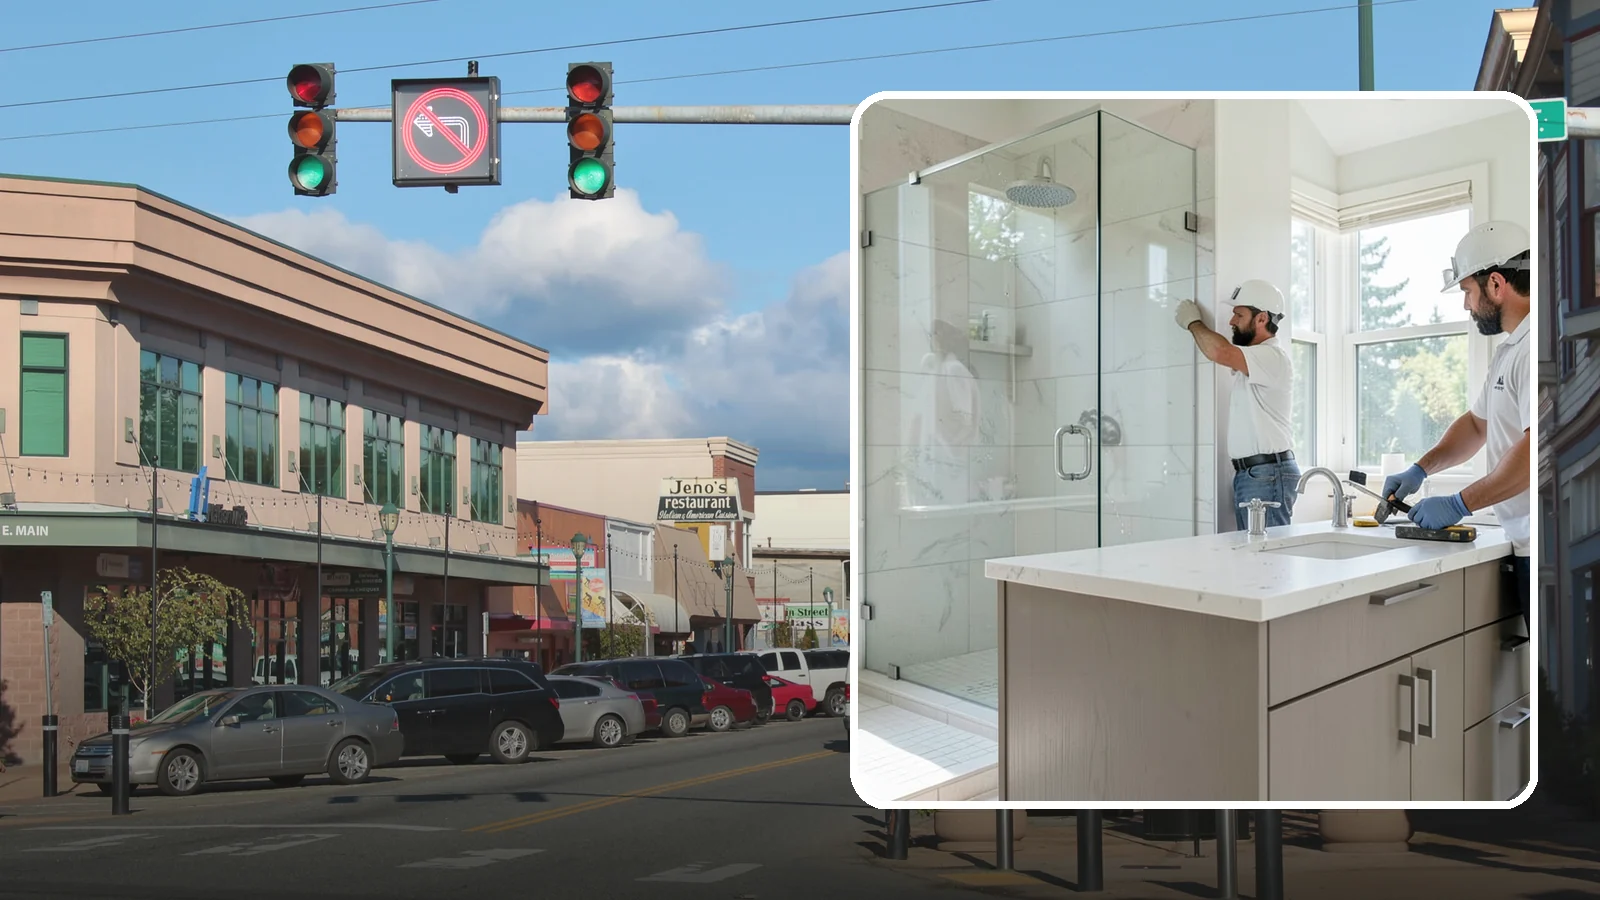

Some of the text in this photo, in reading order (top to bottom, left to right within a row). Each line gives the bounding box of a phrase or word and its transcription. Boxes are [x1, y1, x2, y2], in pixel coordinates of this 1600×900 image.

[669, 480, 728, 495] Jeno's
[665, 496, 731, 509] restaurant
[658, 509, 681, 519] Italian
[685, 509, 715, 520] American
[714, 509, 738, 520] Cuisine
[2, 525, 49, 536] E. MAIN
[797, 608, 828, 617] Street
[790, 619, 824, 627] lass
